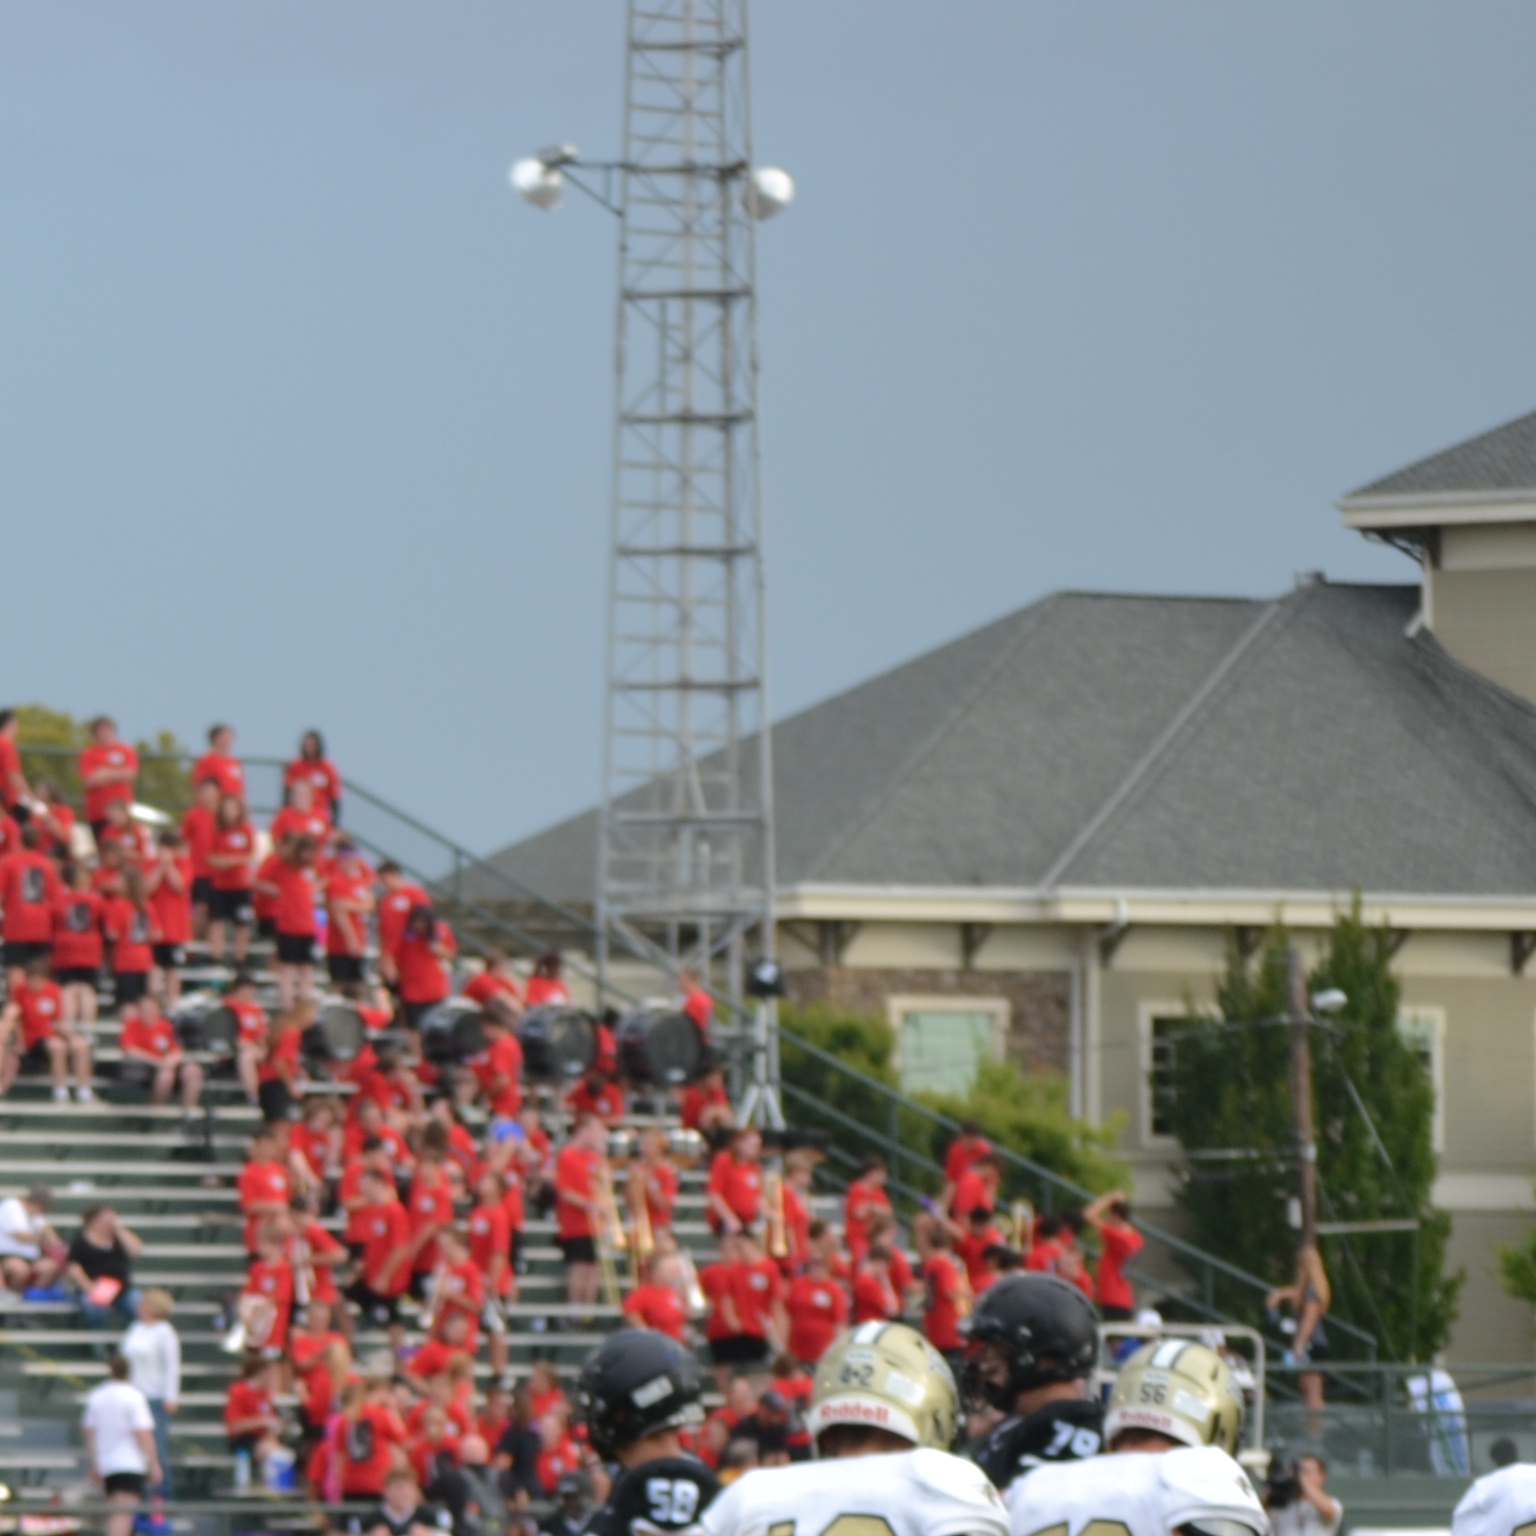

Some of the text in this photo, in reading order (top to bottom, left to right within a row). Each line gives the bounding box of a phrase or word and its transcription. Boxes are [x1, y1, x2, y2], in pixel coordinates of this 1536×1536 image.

[1140, 1381, 1169, 1405] 56
[820, 1402, 890, 1424] Riddell
[646, 1476, 701, 1525] 58
